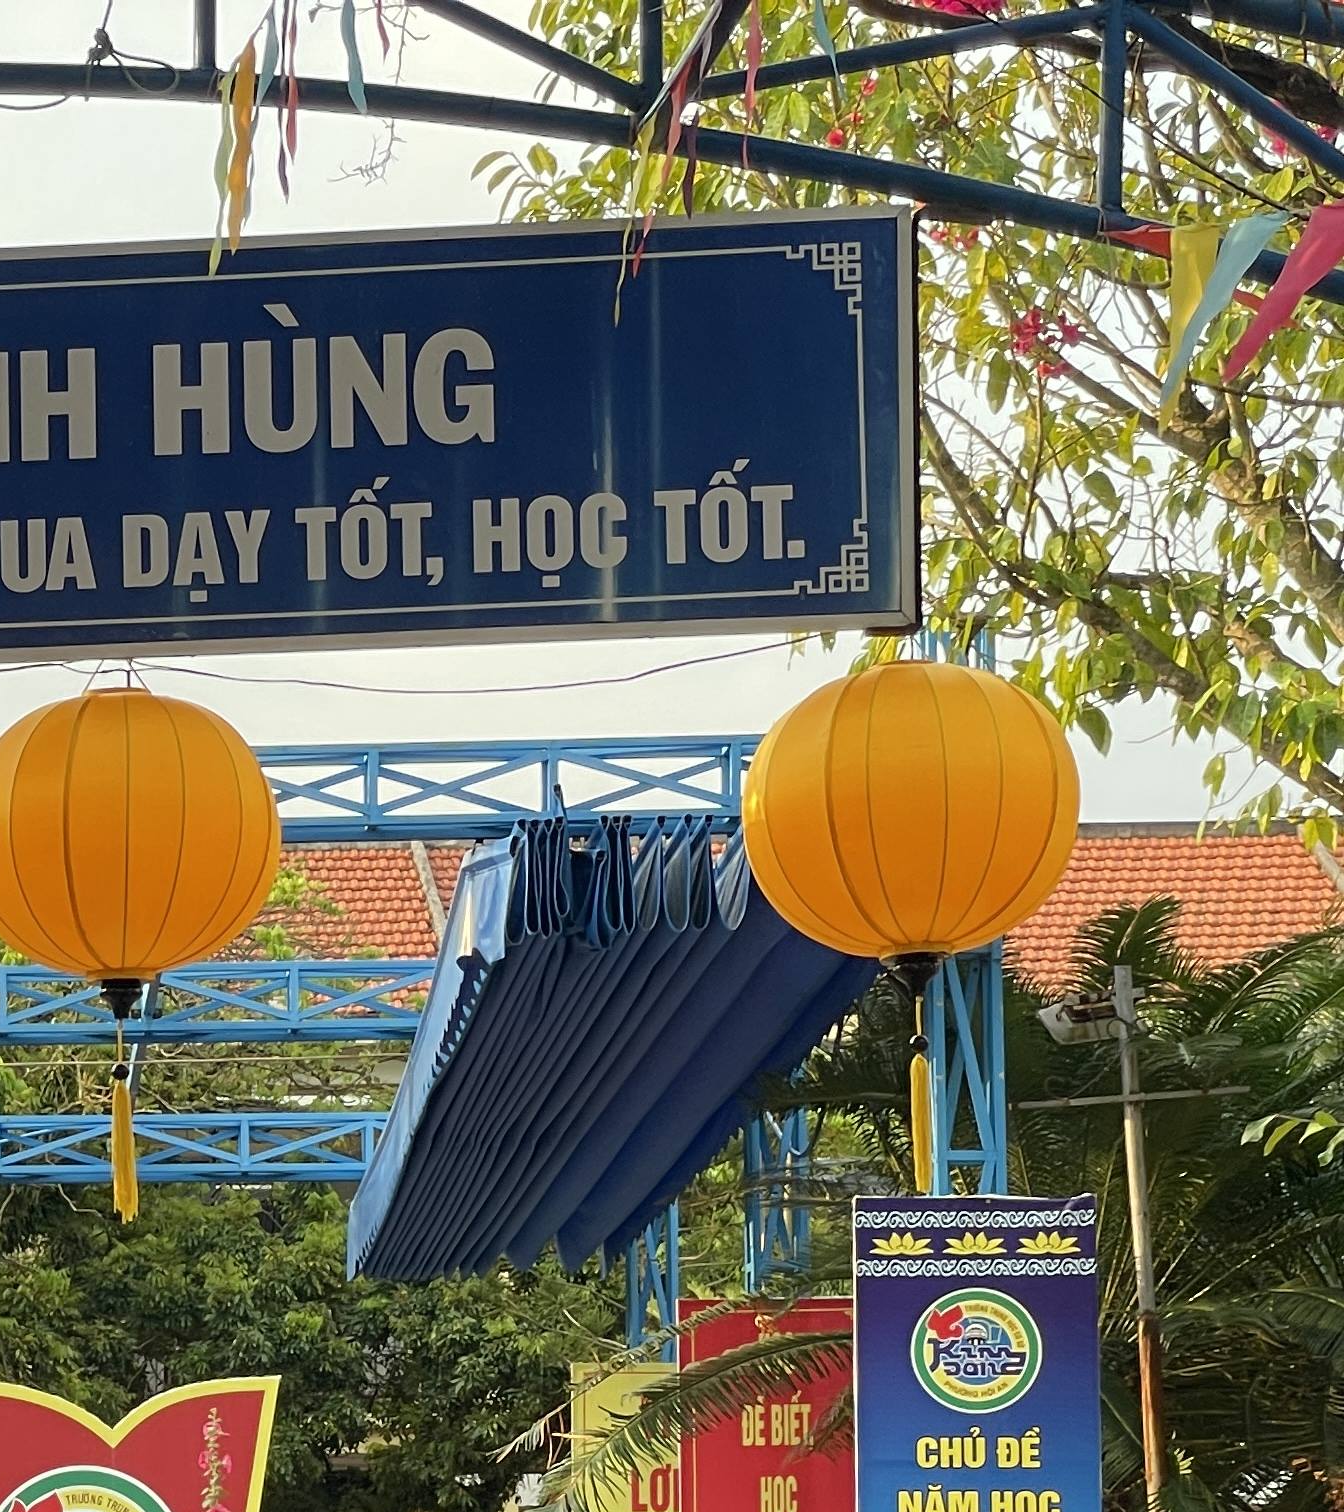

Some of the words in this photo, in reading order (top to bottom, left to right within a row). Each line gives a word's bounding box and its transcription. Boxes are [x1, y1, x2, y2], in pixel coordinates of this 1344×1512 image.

[153, 304, 494, 455] HÙNG
[123, 510, 270, 602] DẠY
[295, 477, 443, 585] TỐT,
[471, 494, 627, 588] HỌC
[654, 459, 805, 564] TỐT.
[916, 1427, 987, 1471] CHỦ
[996, 1427, 1041, 1470] ĐỀ
